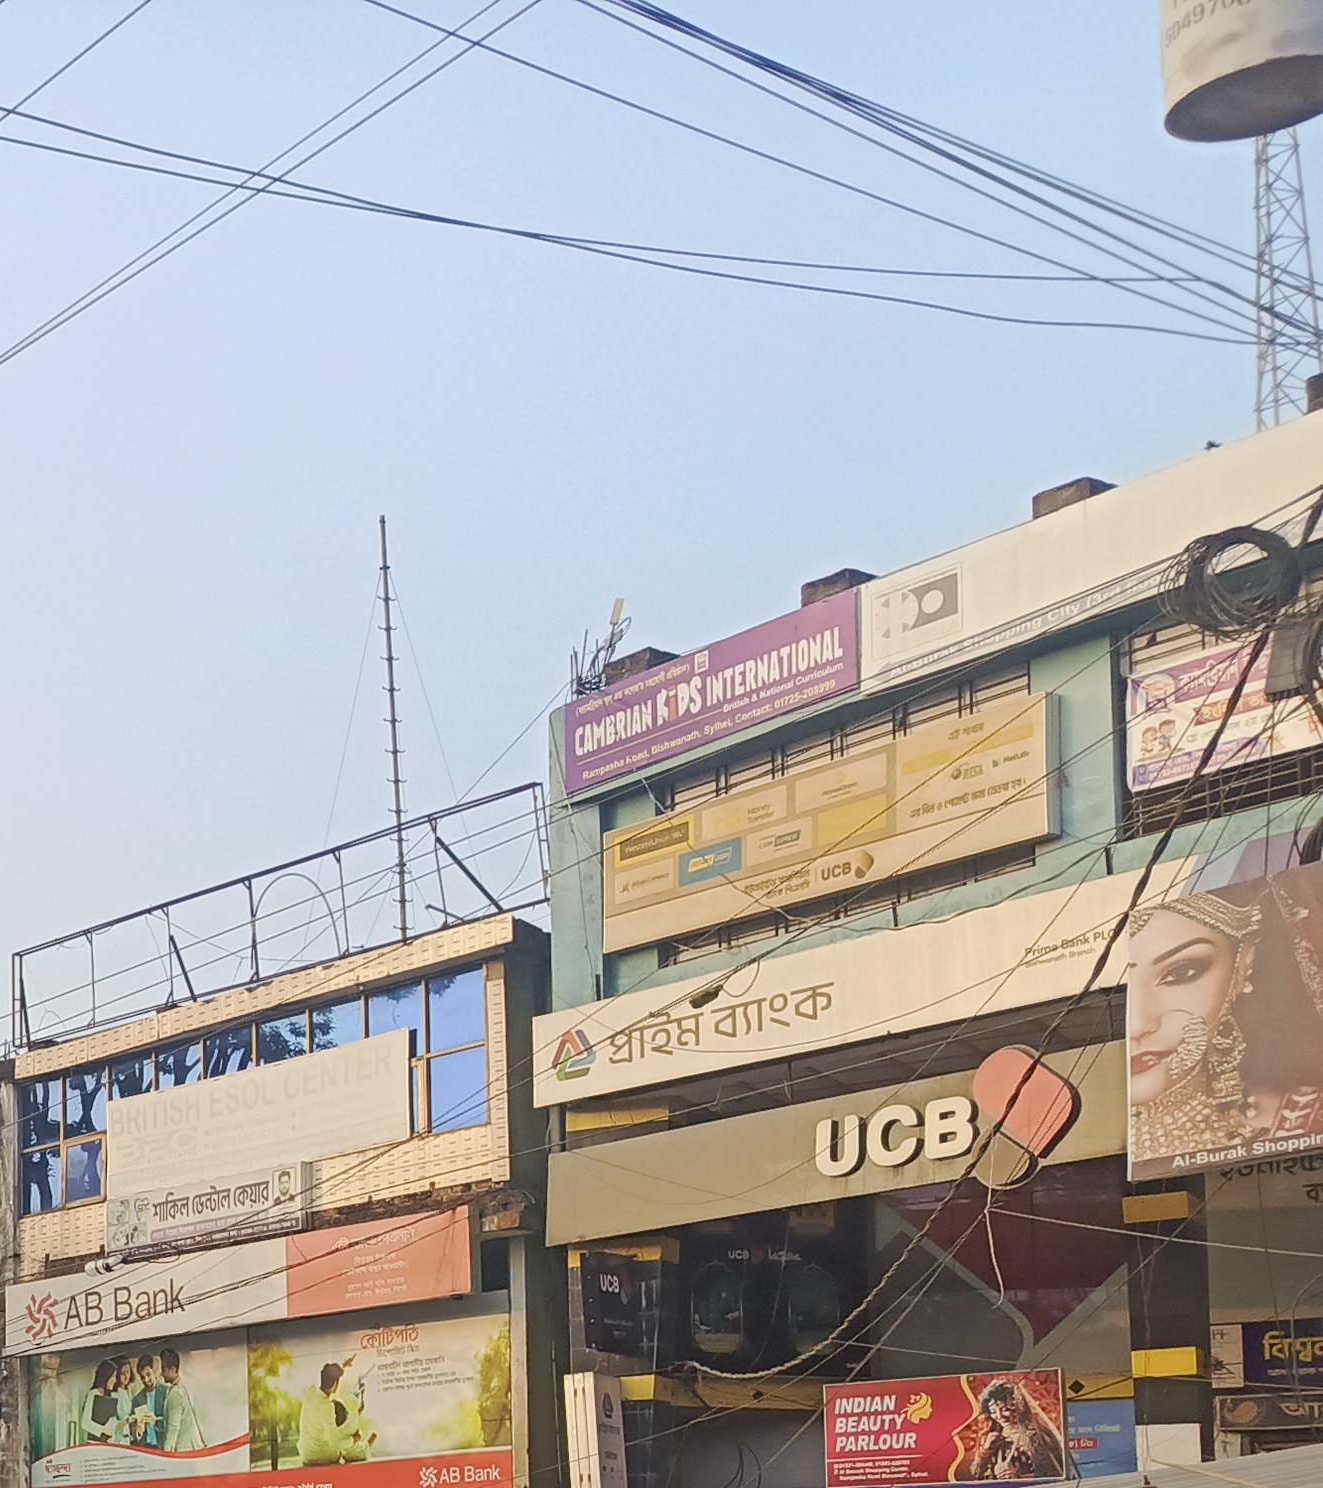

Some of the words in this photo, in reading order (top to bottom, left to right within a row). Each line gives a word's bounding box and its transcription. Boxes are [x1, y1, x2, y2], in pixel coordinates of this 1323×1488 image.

[1047, 601, 1081, 624] City
[575, 700, 653, 756] CAMBRIAN
[706, 626, 843, 707] INTERNATIONAL
[722, 698, 749, 713] British
[750, 693, 758, 703] &
[759, 680, 794, 700] National
[795, 662, 844, 683] Curriculum
[582, 758, 625, 780] Rampasha
[651, 731, 702, 755] Bishwanath,
[735, 707, 773, 723] Contact:
[821, 862, 852, 881] UCB
[1025, 943, 1057, 957] Prime
[1061, 934, 1090, 949] Bank
[607, 1011, 700, 1066] প্রাইম
[713, 981, 835, 1038] ব্যাংক
[111, 1099, 200, 1137] BRITISH
[208, 1082, 276, 1119] ESOL
[283, 1043, 392, 1100] CENTER
[816, 1096, 978, 1178] UCB
[1172, 1146, 1247, 1168] Al-Burak
[152, 1191, 189, 1223] শাকিল
[192, 1185, 231, 1217] ডেন্টাল
[233, 1181, 270, 1209] কেয়ার
[600, 1274, 619, 1293] UCB
[65, 1291, 103, 1329] AB
[114, 1279, 186, 1321] Bank
[360, 1324, 419, 1350] কোটিপতি
[835, 1395, 896, 1414] INDIAN
[835, 1413, 906, 1433] BEAUTY
[836, 1433, 917, 1452] PARLOUR
[439, 1467, 460, 1484] AB
[464, 1464, 501, 1482] Bank
